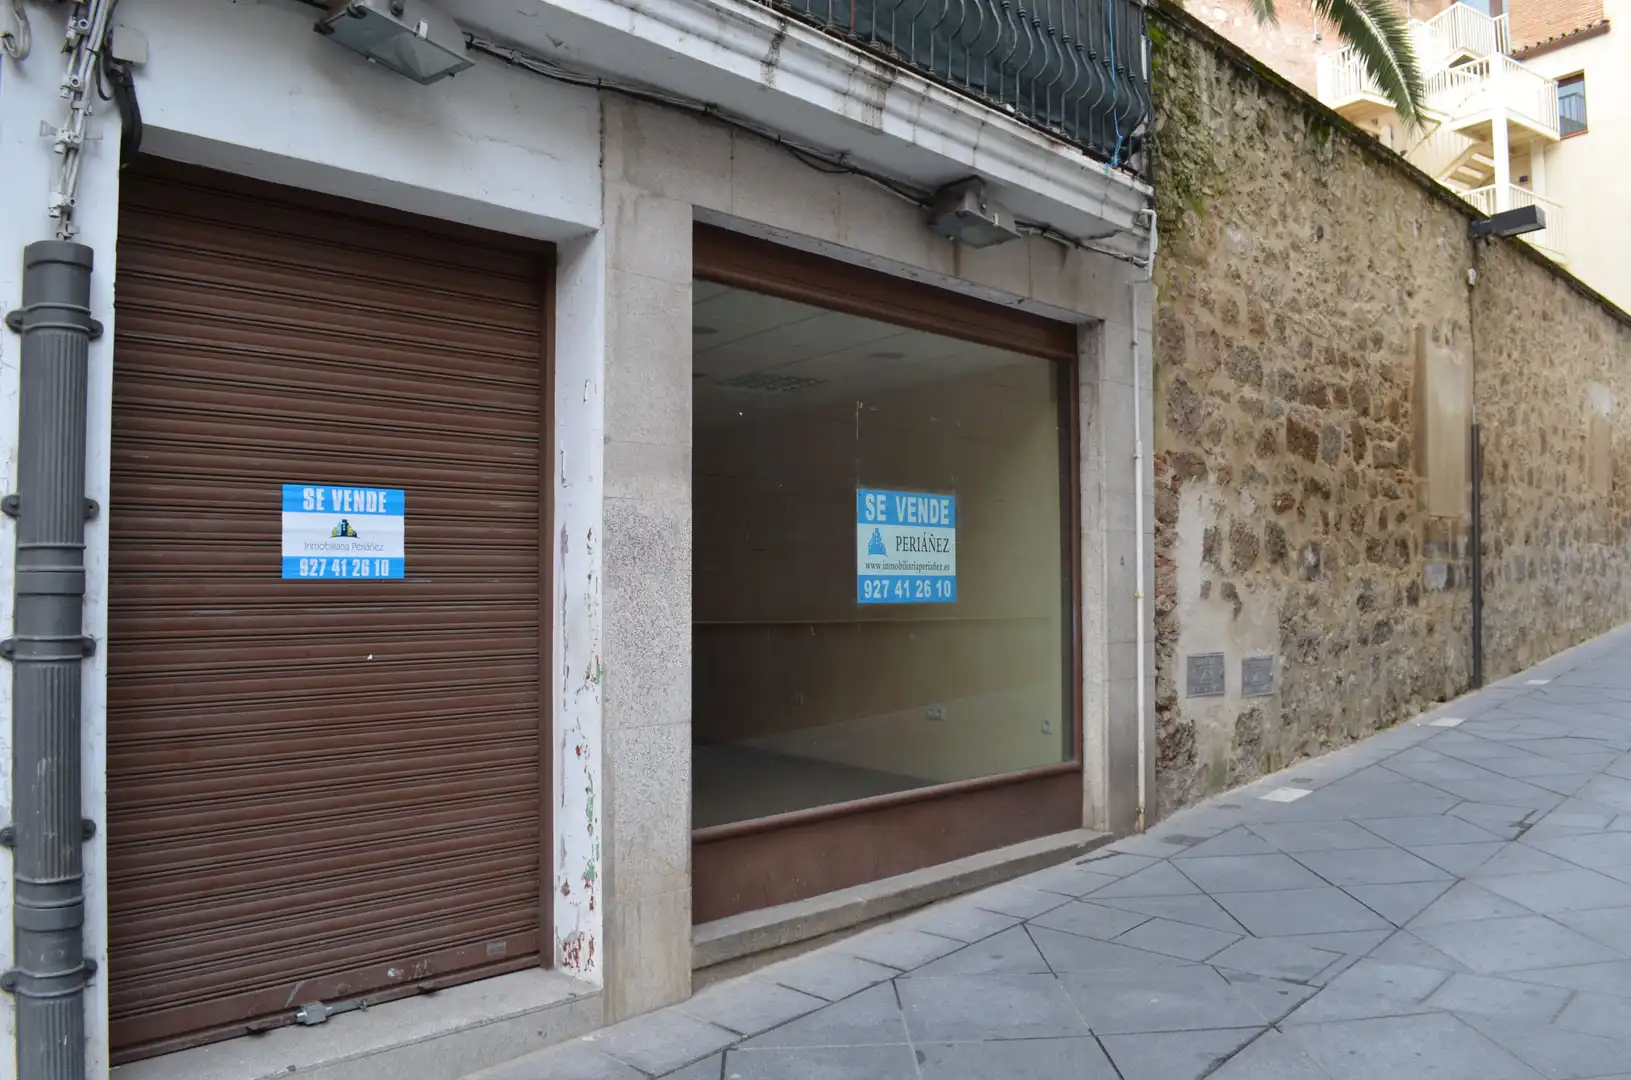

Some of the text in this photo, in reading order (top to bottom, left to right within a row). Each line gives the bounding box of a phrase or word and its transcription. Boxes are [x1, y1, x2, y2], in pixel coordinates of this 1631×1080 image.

[302, 487, 388, 513] SE VENDE
[864, 493, 950, 525] SE VENDE
[895, 531, 950, 554] PERIÁÑEZ
[299, 558, 390, 577] 927 41 26 10
[863, 579, 952, 599] 927 41 26 10
